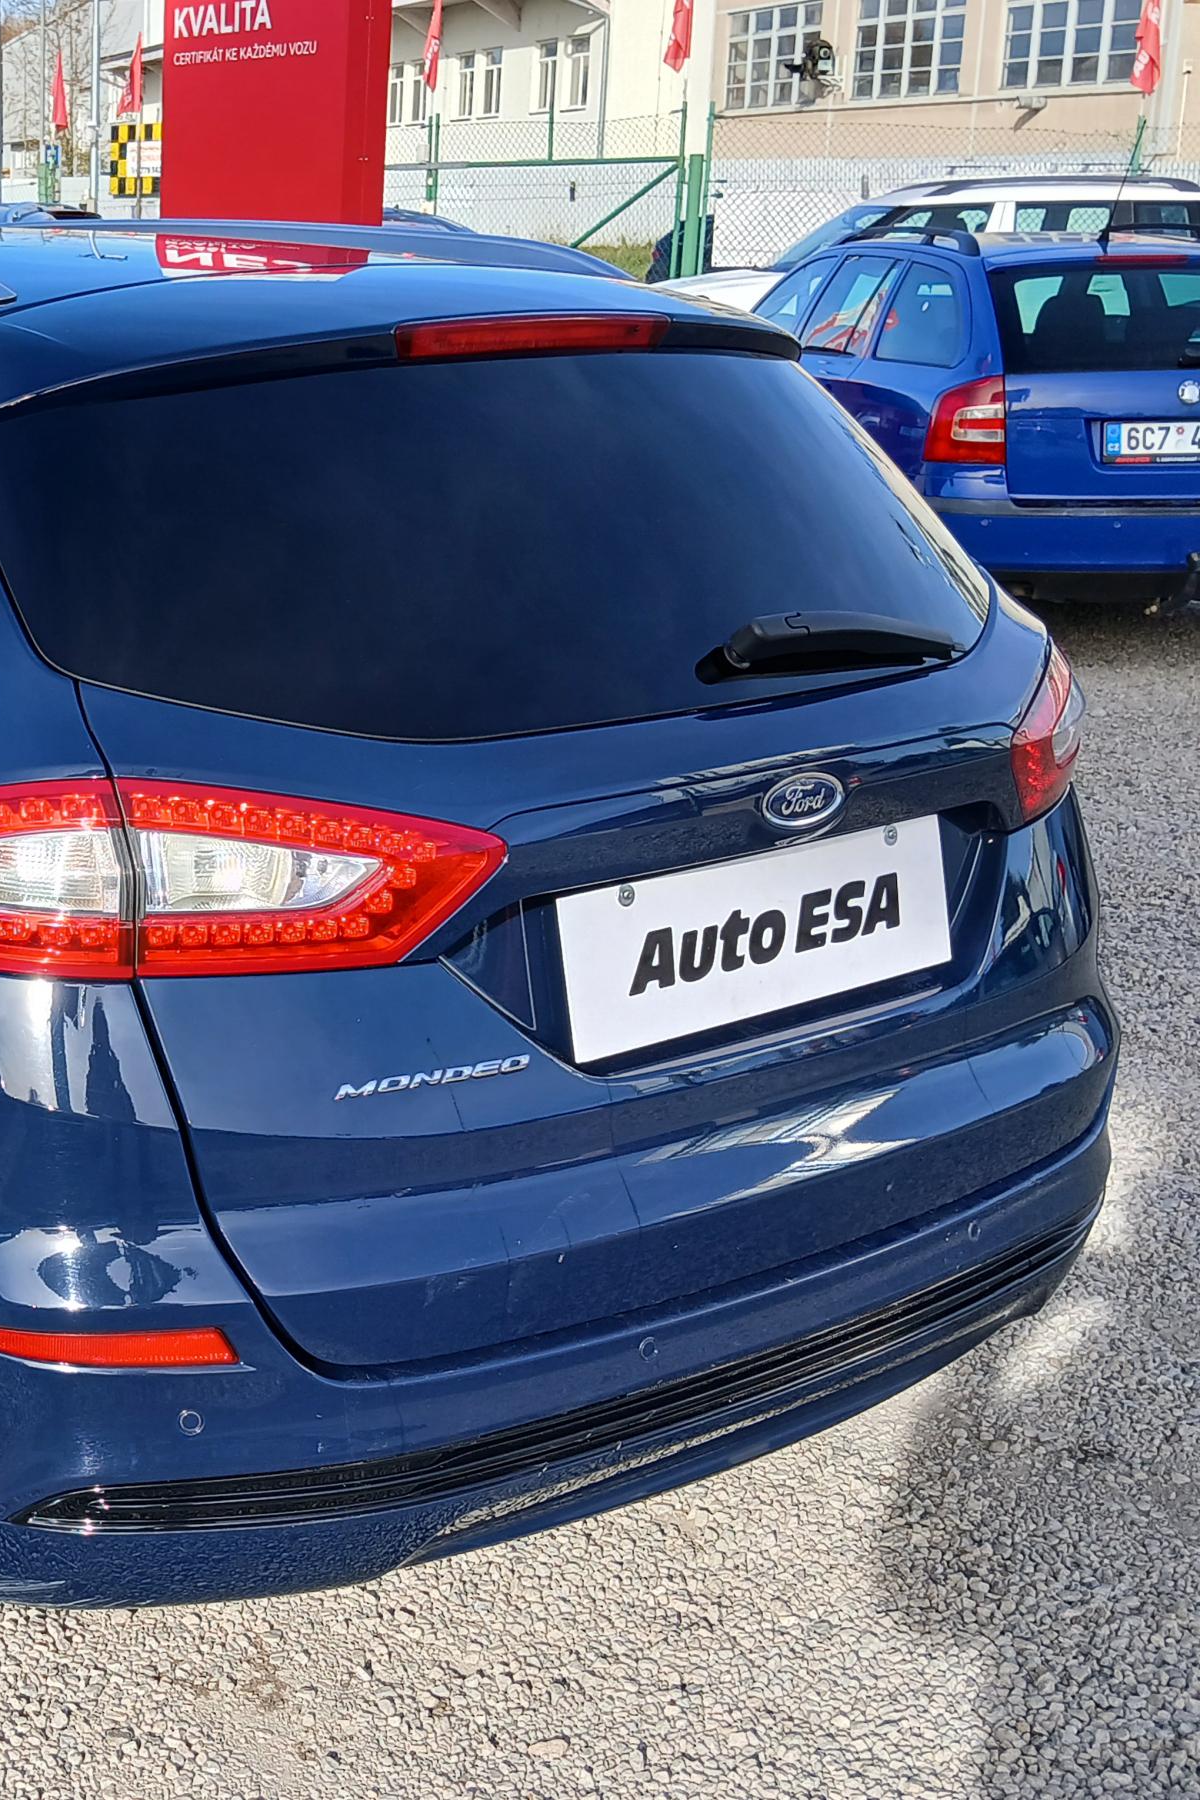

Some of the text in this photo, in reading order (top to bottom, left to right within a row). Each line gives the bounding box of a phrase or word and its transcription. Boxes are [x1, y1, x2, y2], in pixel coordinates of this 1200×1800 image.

[173, 0, 272, 39] KVALITA
[173, 40, 318, 66] CERTIFIKÁT KE KAŽDÉMU VOZU
[1127, 426, 1171, 450] 6C7
[782, 785, 826, 816] Ford
[628, 871, 901, 997] Auto ESA
[334, 1053, 531, 1100] MONDEO
